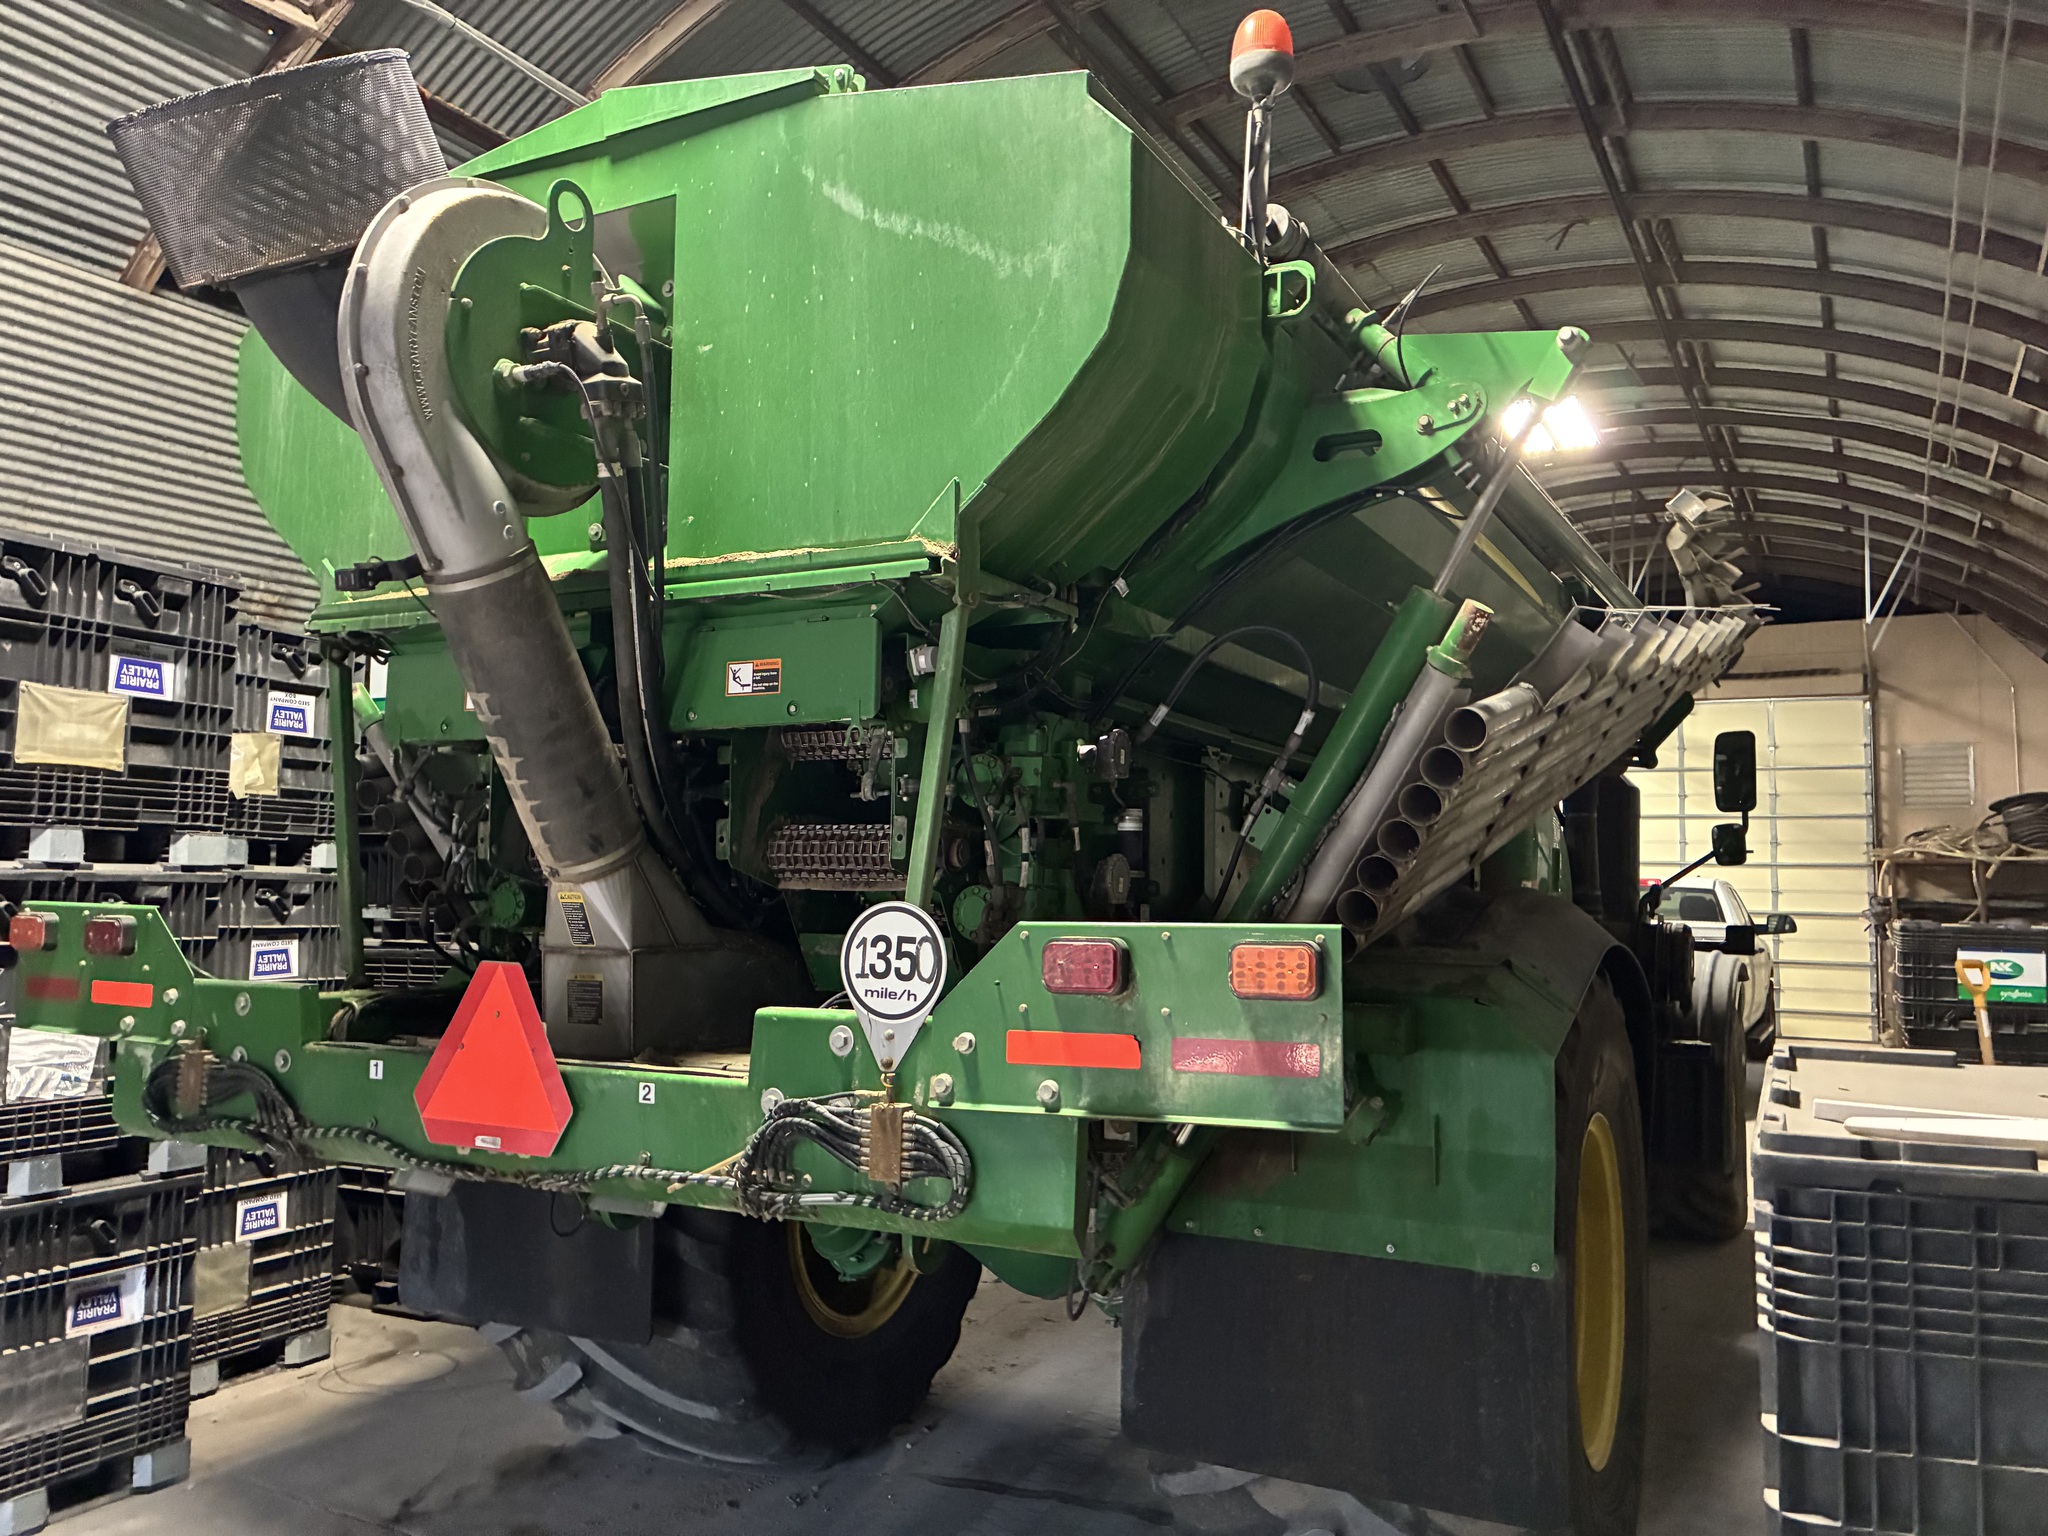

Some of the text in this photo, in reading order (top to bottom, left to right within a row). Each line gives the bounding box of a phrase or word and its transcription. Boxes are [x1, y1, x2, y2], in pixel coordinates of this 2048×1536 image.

[120, 663, 160, 679] VALLEY
[119, 674, 160, 690] PRAIRIE
[270, 697, 297, 705] COMPANY
[274, 710, 304, 721] VALLEY
[273, 718, 304, 729] PRAIRIE
[257, 953, 287, 964] VALLEY
[855, 934, 938, 985] 1350
[257, 962, 288, 972] PRAIRIE
[1990, 961, 2014, 972] NK
[864, 987, 917, 1002] mile/h
[373, 1061, 379, 1077] 1
[642, 1084, 651, 1101] 2
[245, 1208, 276, 1222] VALLEY
[244, 1217, 276, 1231] PRAIRIE
[76, 1302, 117, 1321] PRAIRIE
